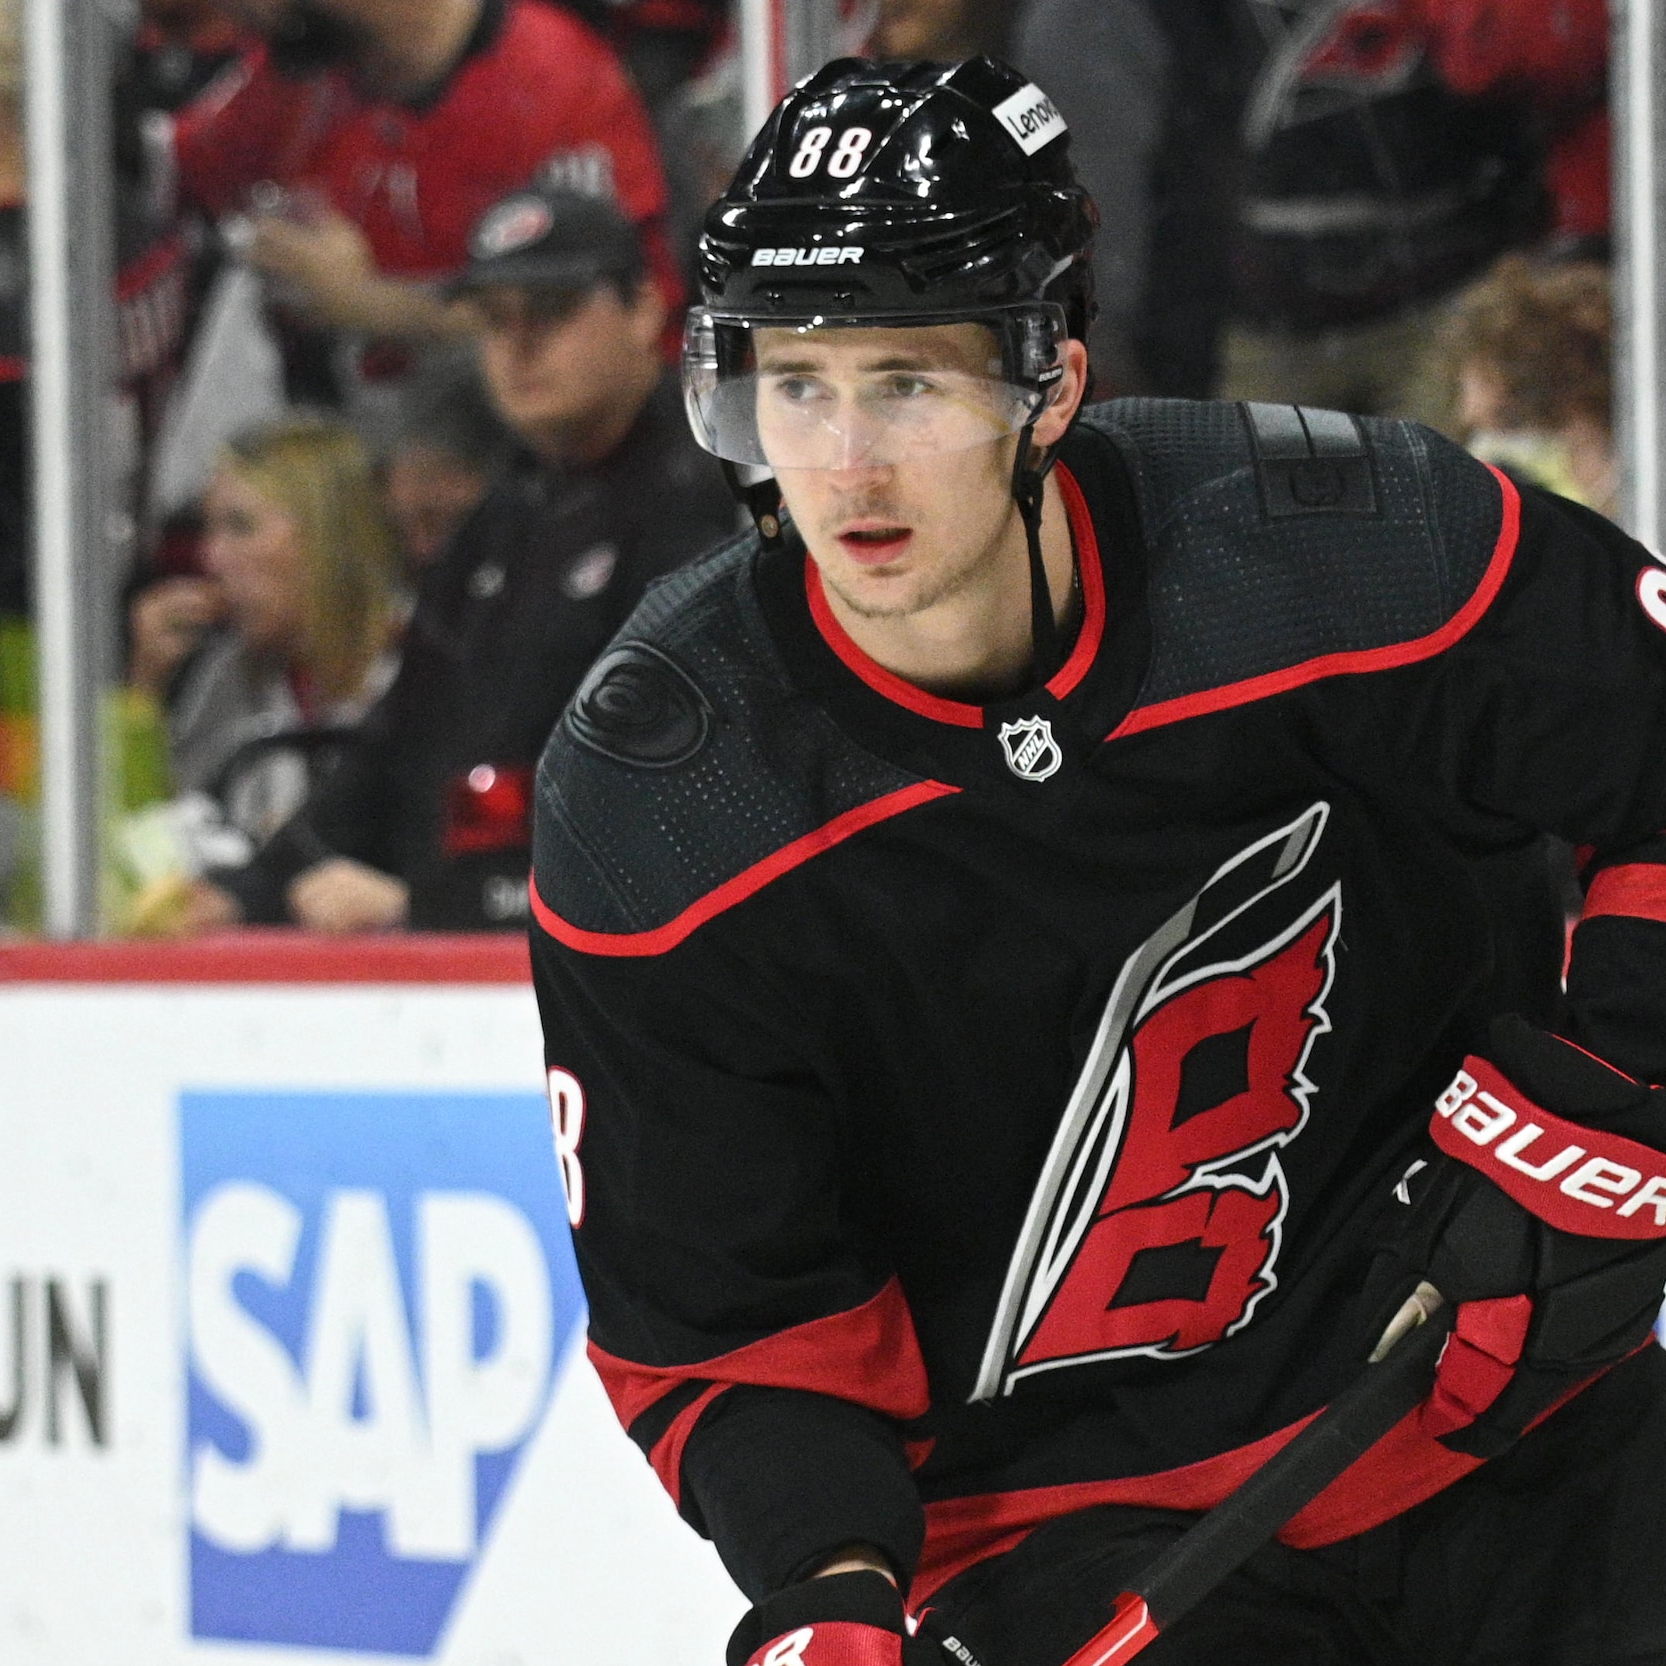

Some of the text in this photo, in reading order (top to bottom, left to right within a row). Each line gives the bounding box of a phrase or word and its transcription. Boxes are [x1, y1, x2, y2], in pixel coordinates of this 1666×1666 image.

[1007, 97, 1060, 140] Lenov
[789, 126, 872, 179] 88
[1017, 733, 1046, 772] NHL
[188, 1180, 554, 1561] SAP
